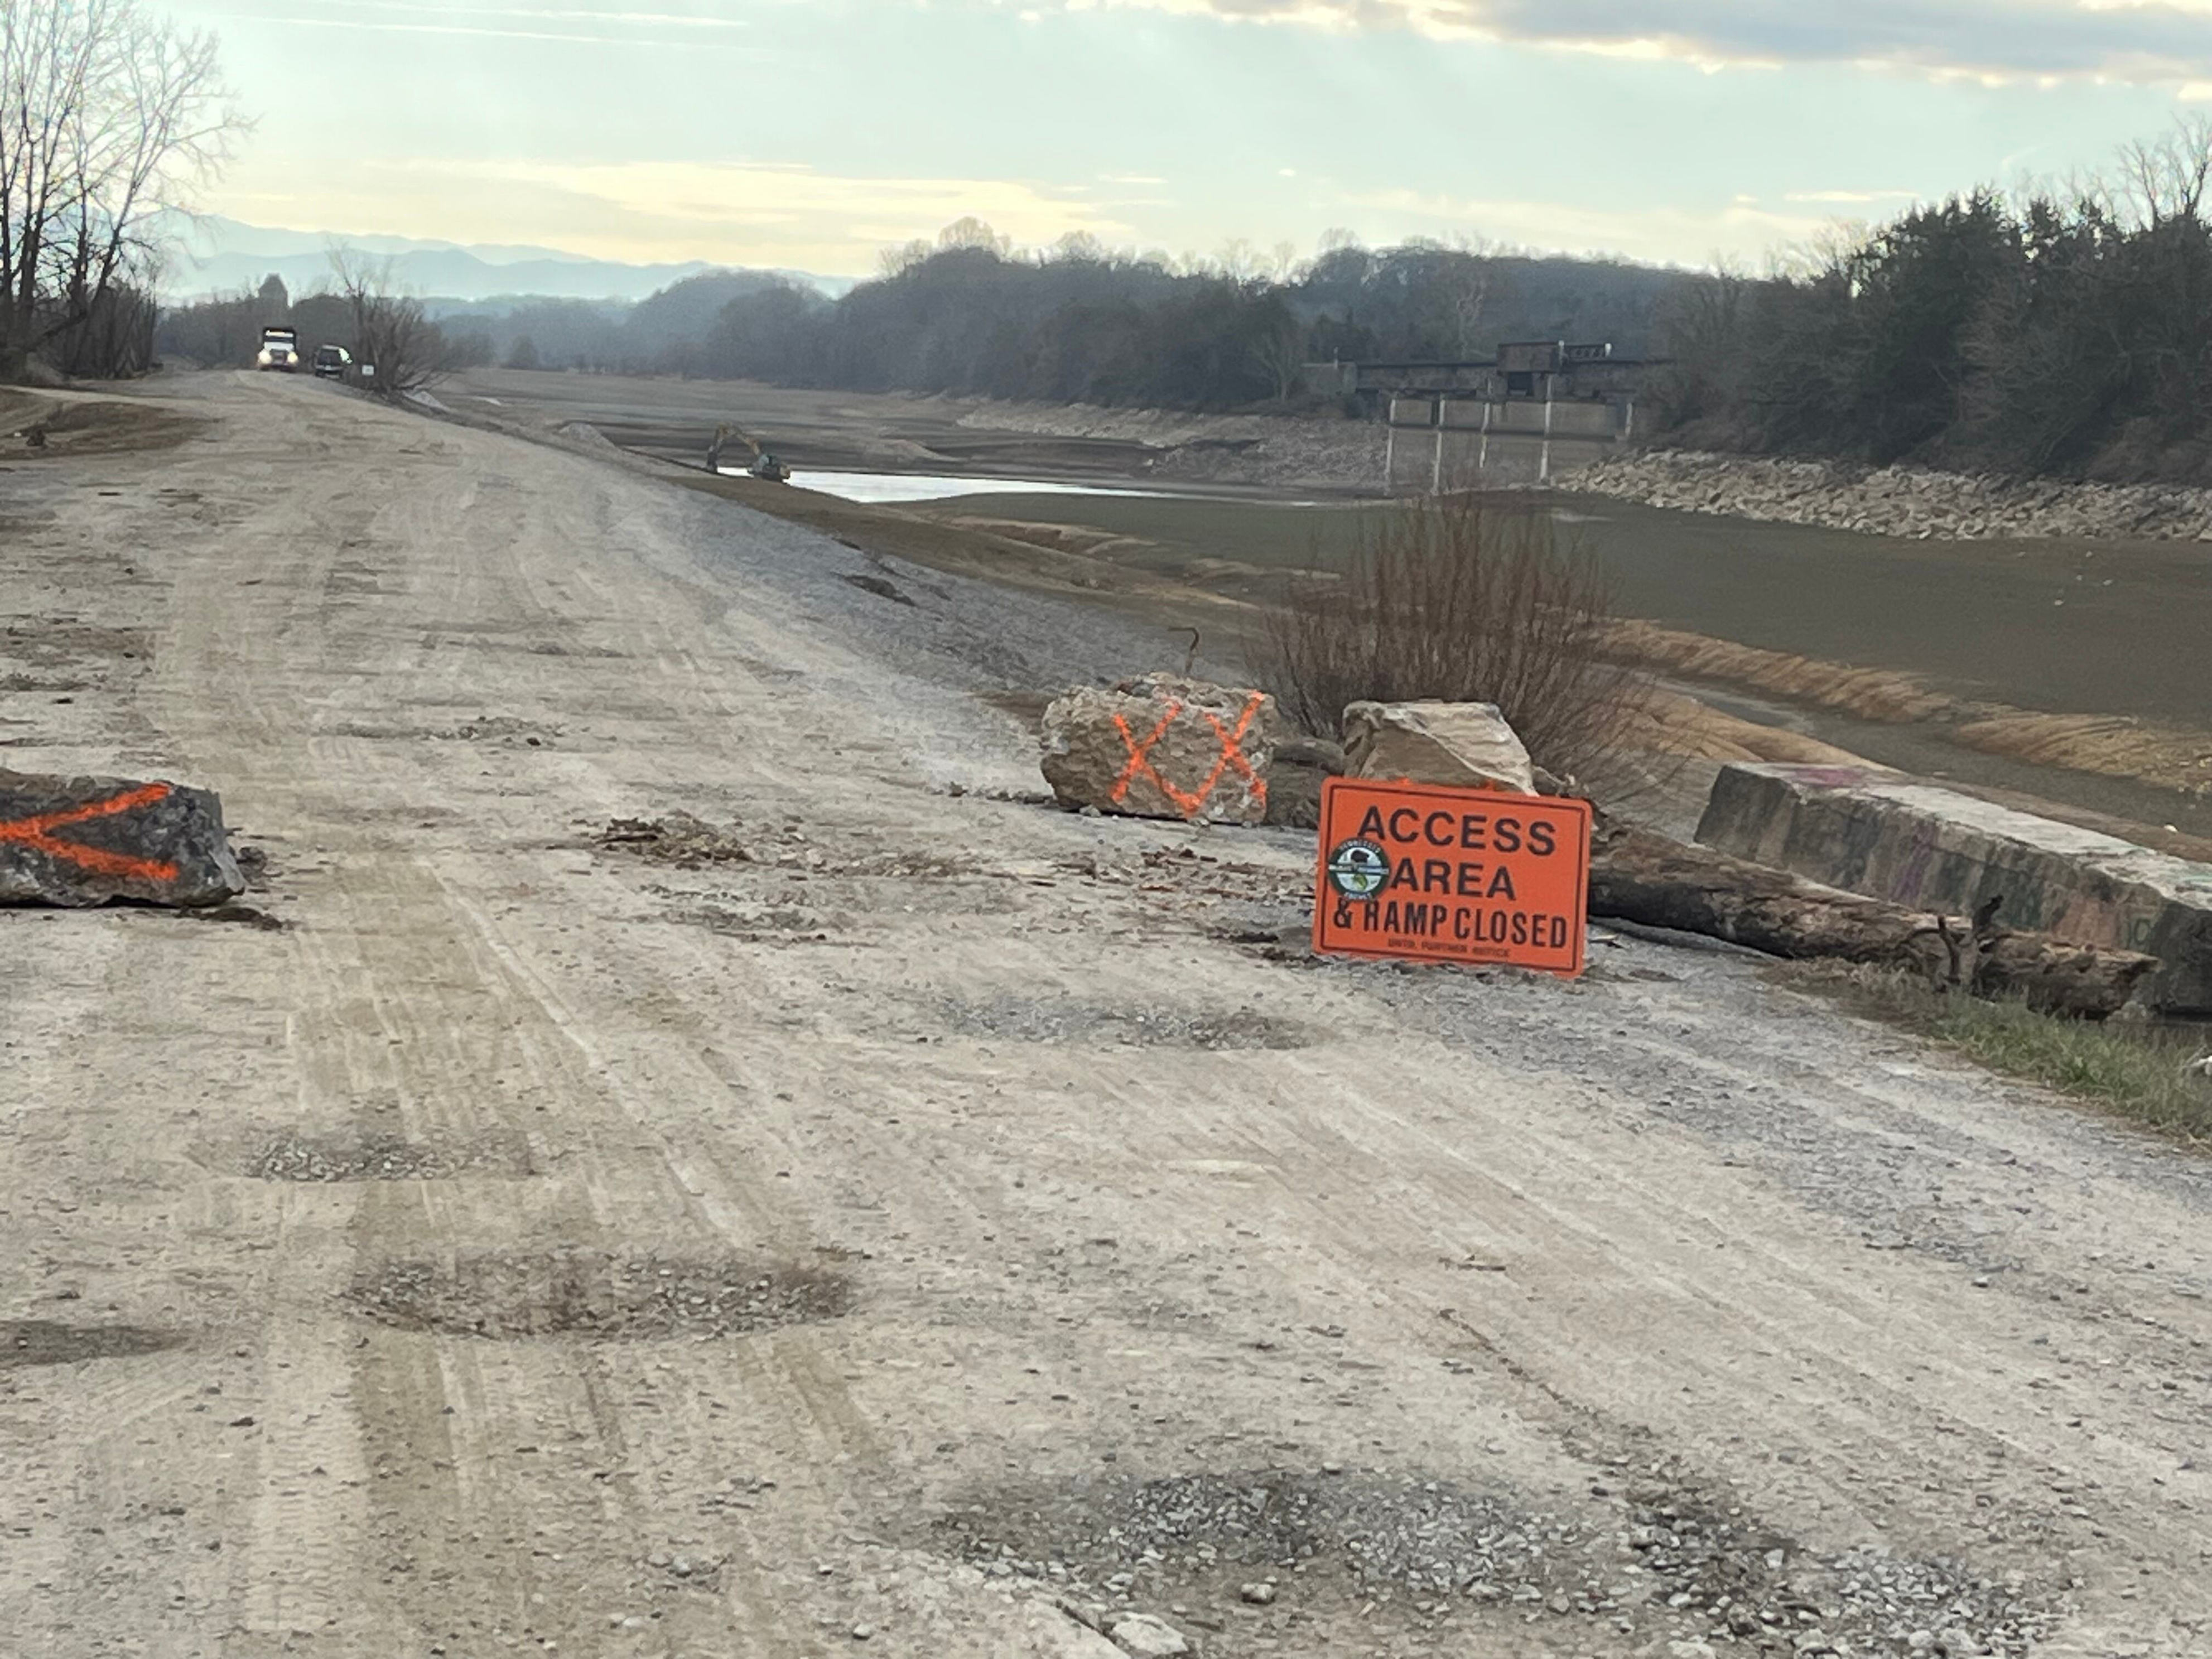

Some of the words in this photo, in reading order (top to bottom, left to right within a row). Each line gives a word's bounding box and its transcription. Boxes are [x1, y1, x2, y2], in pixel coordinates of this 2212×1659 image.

[1357, 806, 1556, 856] ACCESS
[1391, 857, 1516, 900] AREA
[1333, 899, 1353, 929] &
[1454, 907, 1567, 948] CLOSED
